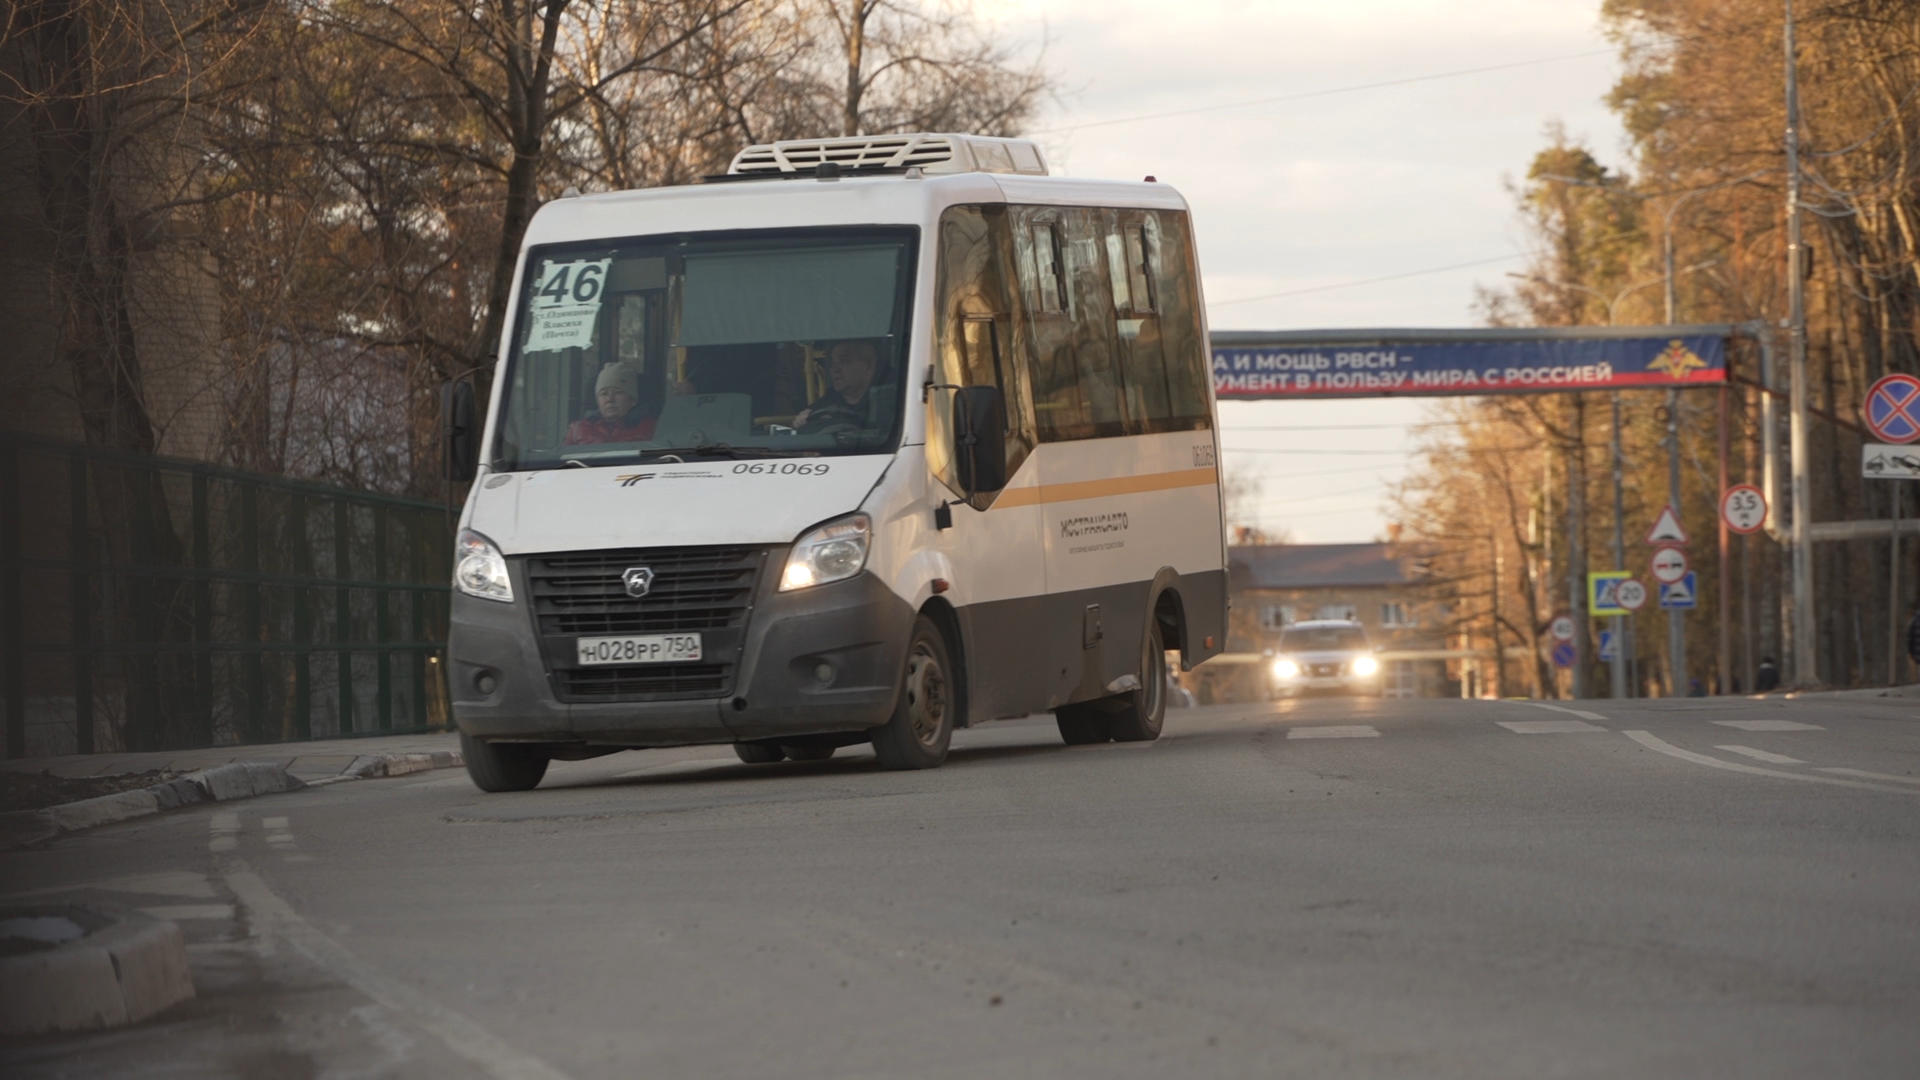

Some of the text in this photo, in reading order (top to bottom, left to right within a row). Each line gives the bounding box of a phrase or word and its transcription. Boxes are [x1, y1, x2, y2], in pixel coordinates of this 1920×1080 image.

[541, 264, 603, 302] 46
[542, 331, 579, 340] (Почта)
[1234, 353, 1250, 370] И
[1256, 353, 1330, 372] МОЩЬ
[1335, 352, 1396, 369] РВСН
[1296, 374, 1310, 388] В
[1317, 371, 1407, 389] ПОЛЬЗУ
[1413, 369, 1479, 386] МИРА
[1484, 369, 1499, 384] С
[1504, 362, 1612, 384] РОССИЕЙ
[732, 463, 830, 476] 061069
[1060, 512, 1128, 537] МОСТРАНСАВТО
[1622, 586, 1641, 601] 20
[585, 636, 695, 662] Н028РР 750
